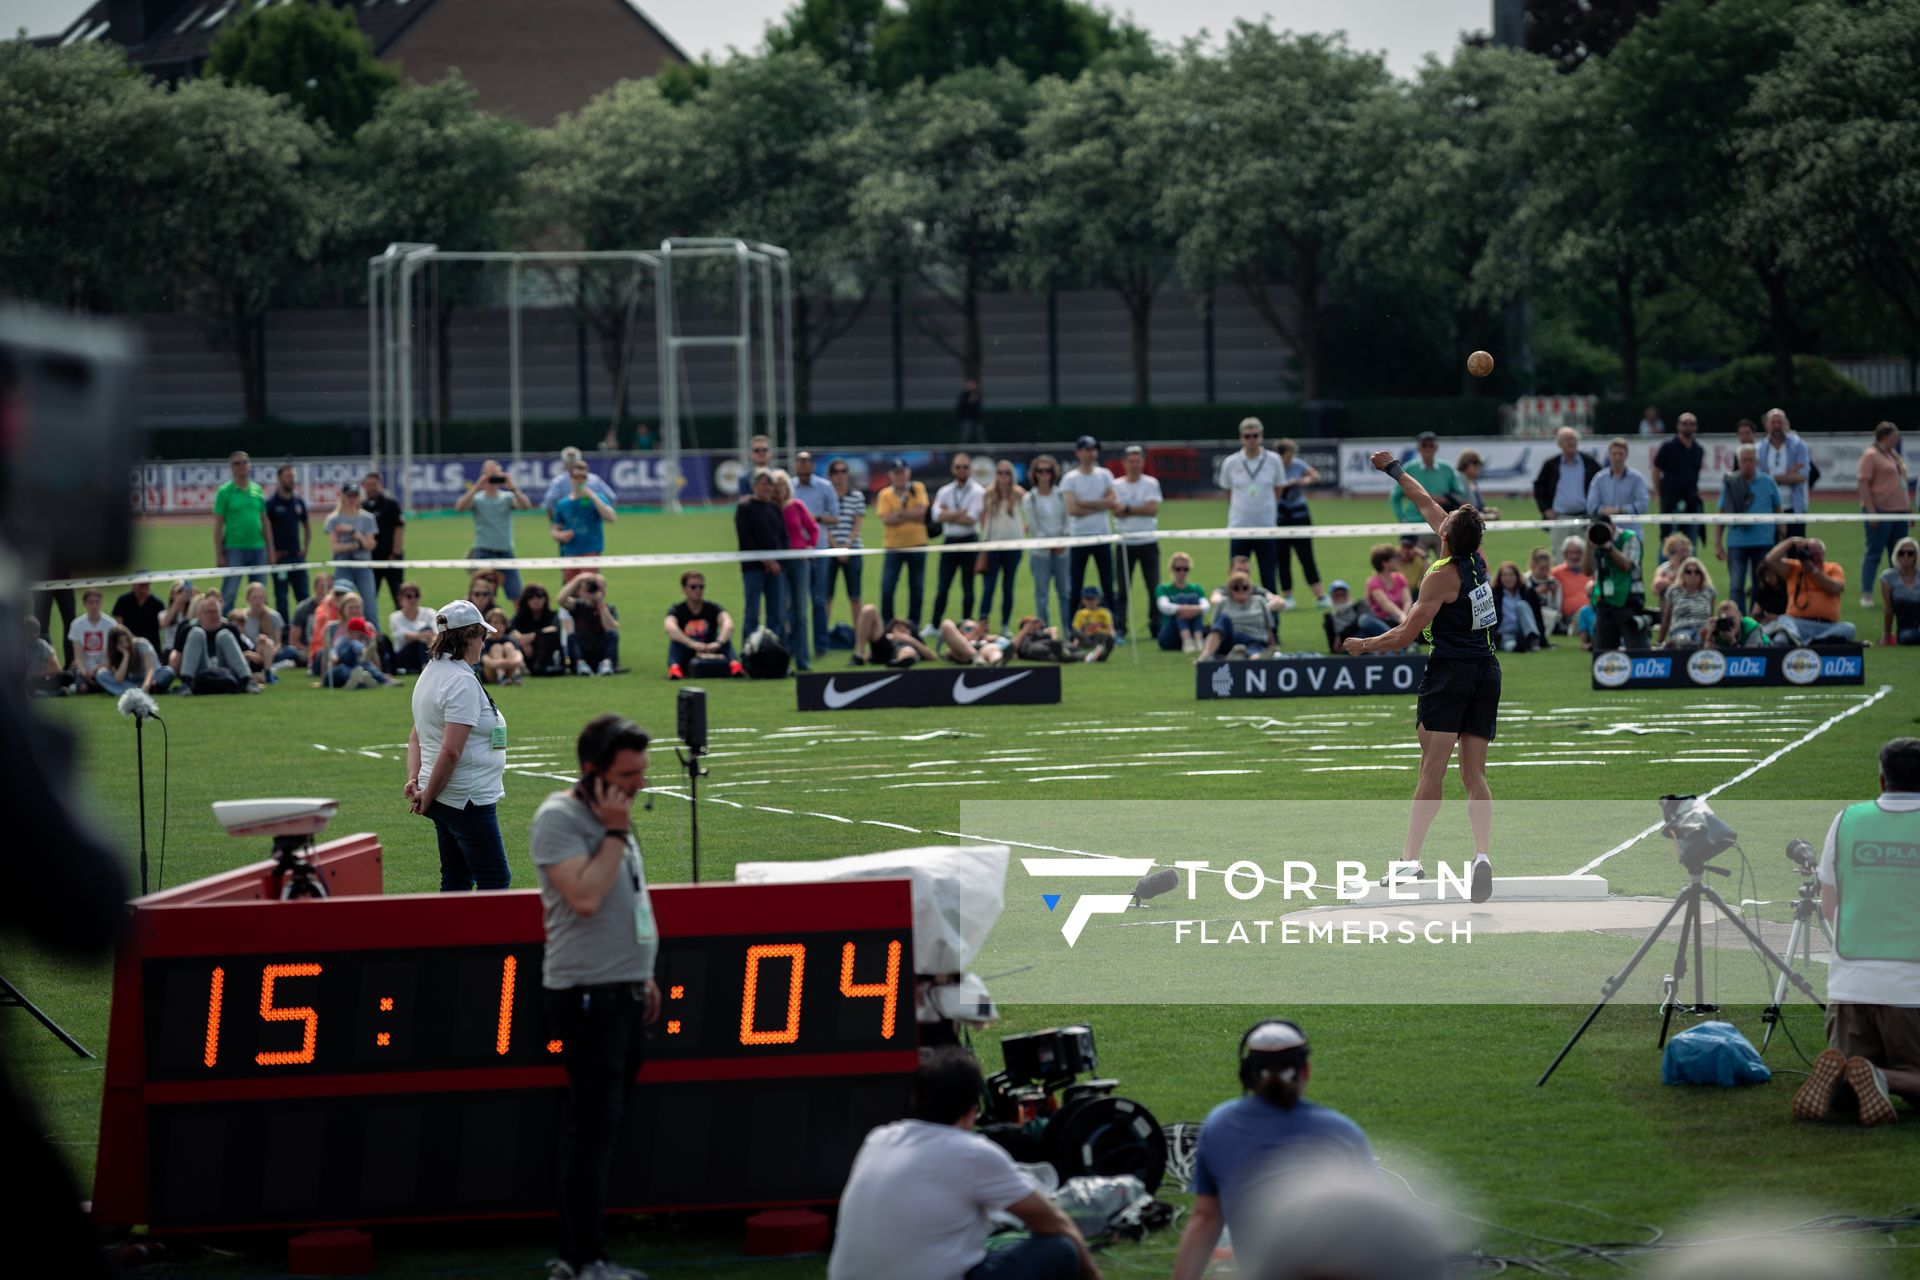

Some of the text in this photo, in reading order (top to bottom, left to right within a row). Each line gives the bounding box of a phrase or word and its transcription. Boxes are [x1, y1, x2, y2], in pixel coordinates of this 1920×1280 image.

[400, 463, 464, 491] GLS
[508, 460, 564, 488] GLS
[611, 460, 674, 486] GLS
[1475, 586, 1488, 600] GLS
[1245, 664, 1414, 693] NOVAFO
[1885, 845, 1920, 860] PLA
